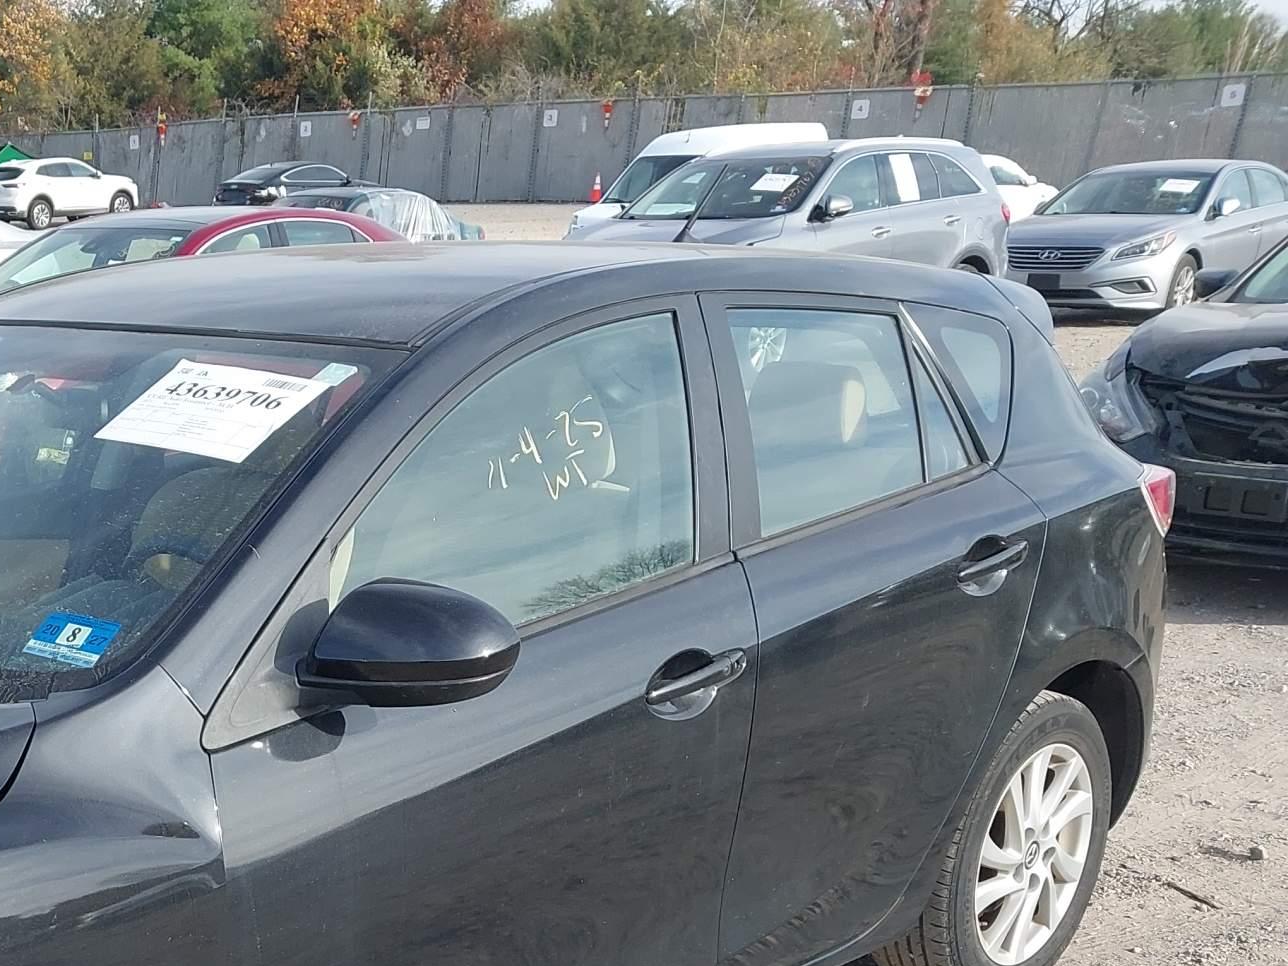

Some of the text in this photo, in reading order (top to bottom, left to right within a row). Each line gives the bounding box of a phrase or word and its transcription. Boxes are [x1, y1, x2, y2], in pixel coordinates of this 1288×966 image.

[165, 380, 290, 411] 43639706
[42, 623, 109, 647] 20 8 27
